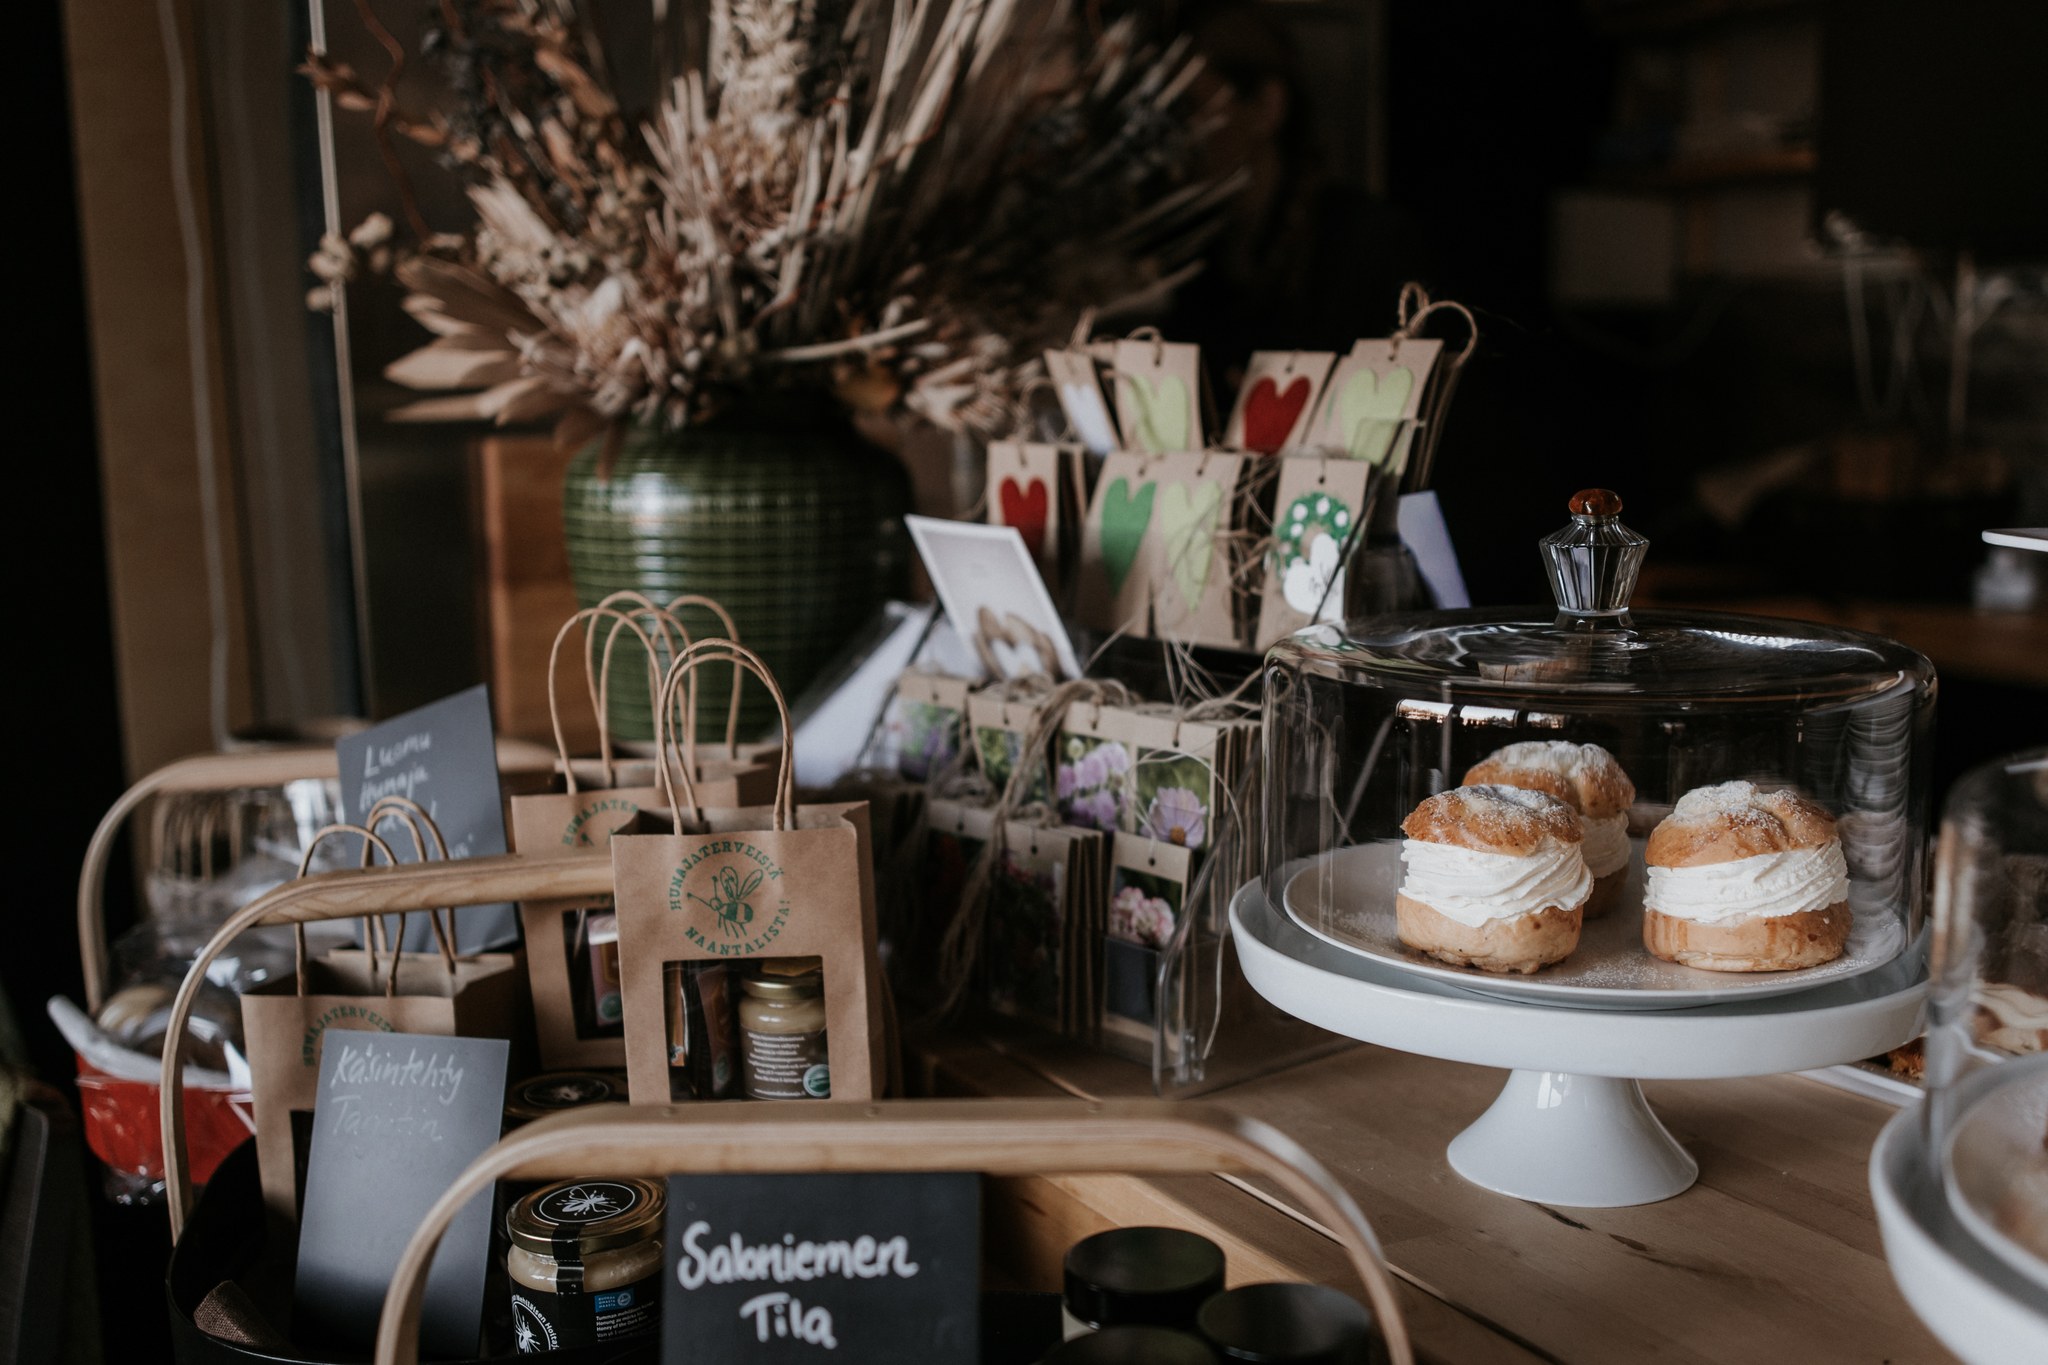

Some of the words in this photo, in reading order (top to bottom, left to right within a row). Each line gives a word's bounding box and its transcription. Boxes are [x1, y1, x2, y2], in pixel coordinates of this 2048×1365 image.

[669, 841, 785, 911] HUNAJATERVEISIÄ
[685, 900, 790, 956] NAANTALISTA!
[329, 1042, 464, 1105] Käsintehty
[677, 1220, 919, 1290] Saloniemen
[739, 1291, 838, 1349] Tila
